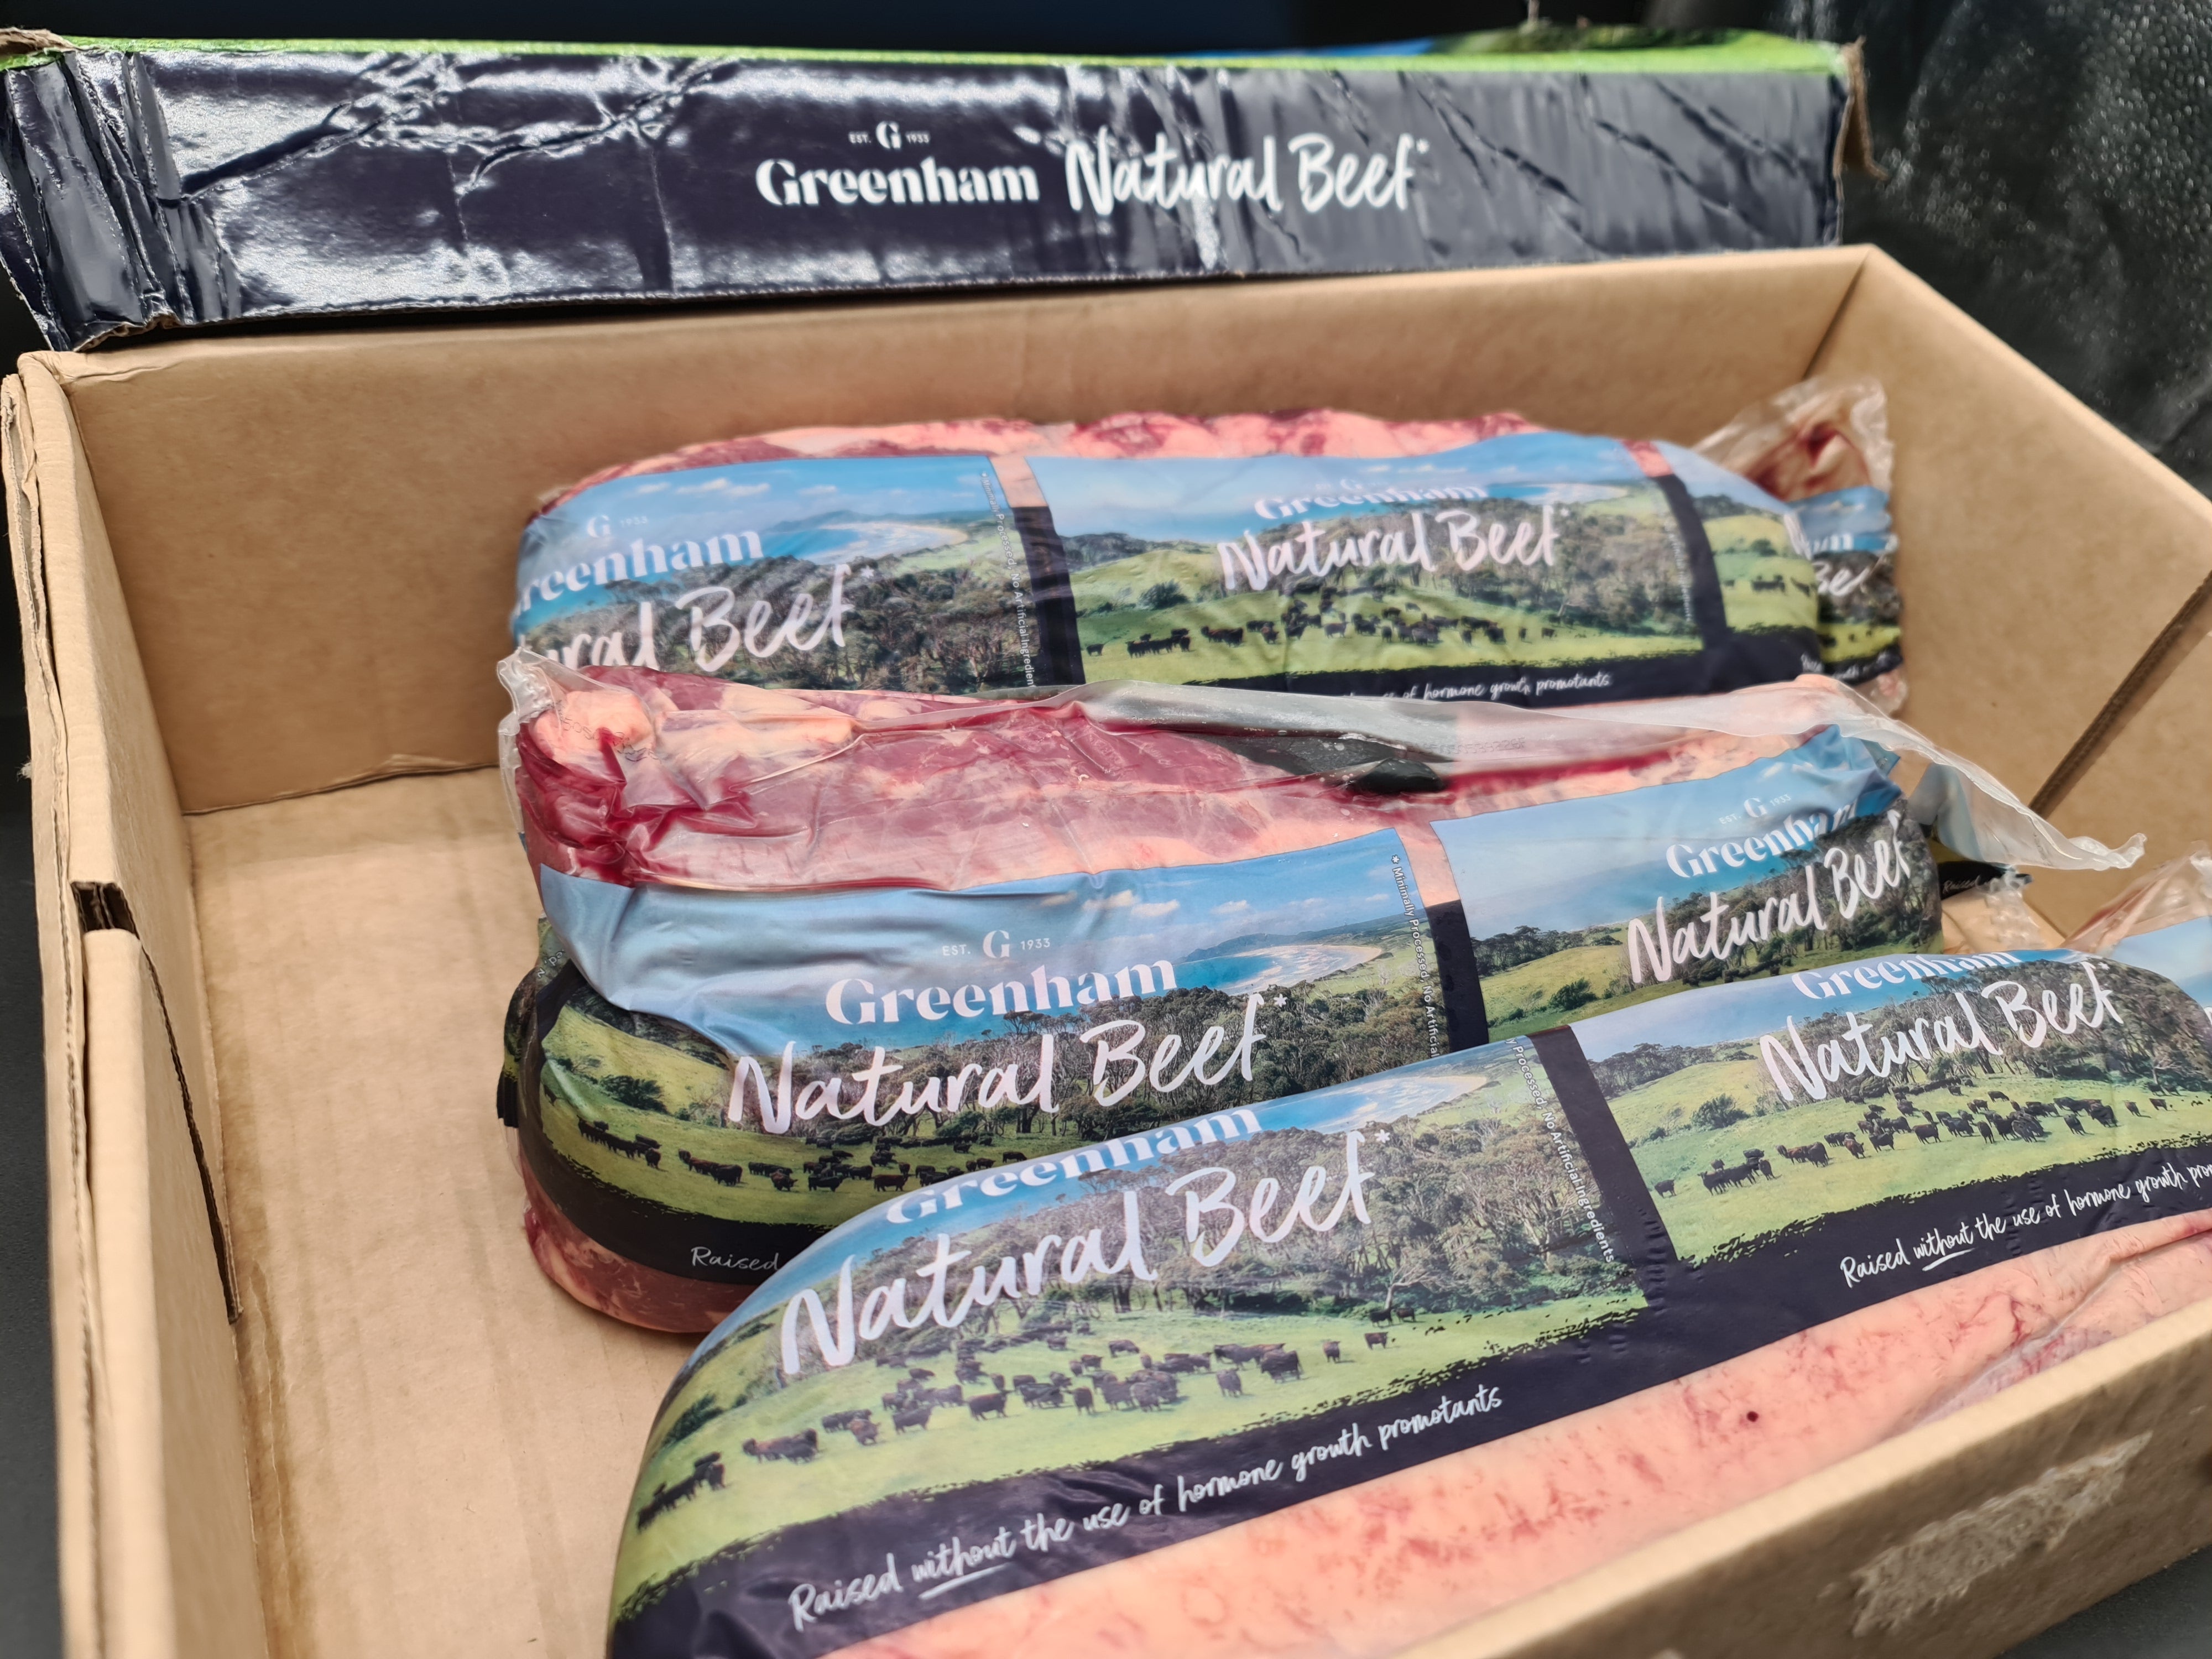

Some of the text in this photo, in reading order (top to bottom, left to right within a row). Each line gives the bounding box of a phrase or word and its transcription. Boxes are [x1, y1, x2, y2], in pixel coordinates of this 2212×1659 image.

[756, 157, 1040, 206] Greenham
[1065, 126, 1284, 215] Natural
[848, 120, 931, 149] EST. G 1933
[587, 514, 611, 538] G
[995, 514, 1018, 570] Processed,
[1217, 512, 1439, 591] Natural
[514, 530, 764, 617] reenham
[1010, 573, 1020, 589] No
[1014, 591, 1029, 636] Artificial
[1423, 682, 1486, 700] hormone
[1490, 676, 1530, 700] growth
[1536, 671, 1610, 696] promotants
[1719, 794, 1792, 825] EST. G 1933
[942, 930, 1050, 958] EST. G 1933
[1392, 867, 1440, 1057] Minimally Processed, No Artificial
[1627, 865, 1827, 983] Natural
[826, 959, 1177, 1025] Greenham
[1792, 952, 2022, 999] Greenham
[728, 1034, 1060, 1134] Natural
[1760, 992, 2004, 1101] Natural
[886, 1106, 1262, 1223] Greenham
[1512, 1046, 1614, 1263] Processed, No Artificial Ingredients
[691, 1246, 780, 1270] Raised
[1840, 1238, 1911, 1288] Raised
[1913, 1222, 1974, 1262] without
[1974, 1213, 2006, 1240] the
[2013, 1208, 2041, 1227] use
[2046, 1193, 2062, 1218] of
[2064, 1183, 2131, 1216] hormone
[2135, 1162, 2188, 1203] growth
[782, 1191, 1157, 1376] Natural
[788, 1384, 1503, 1632] Raised without the use of hormone growth promotants
